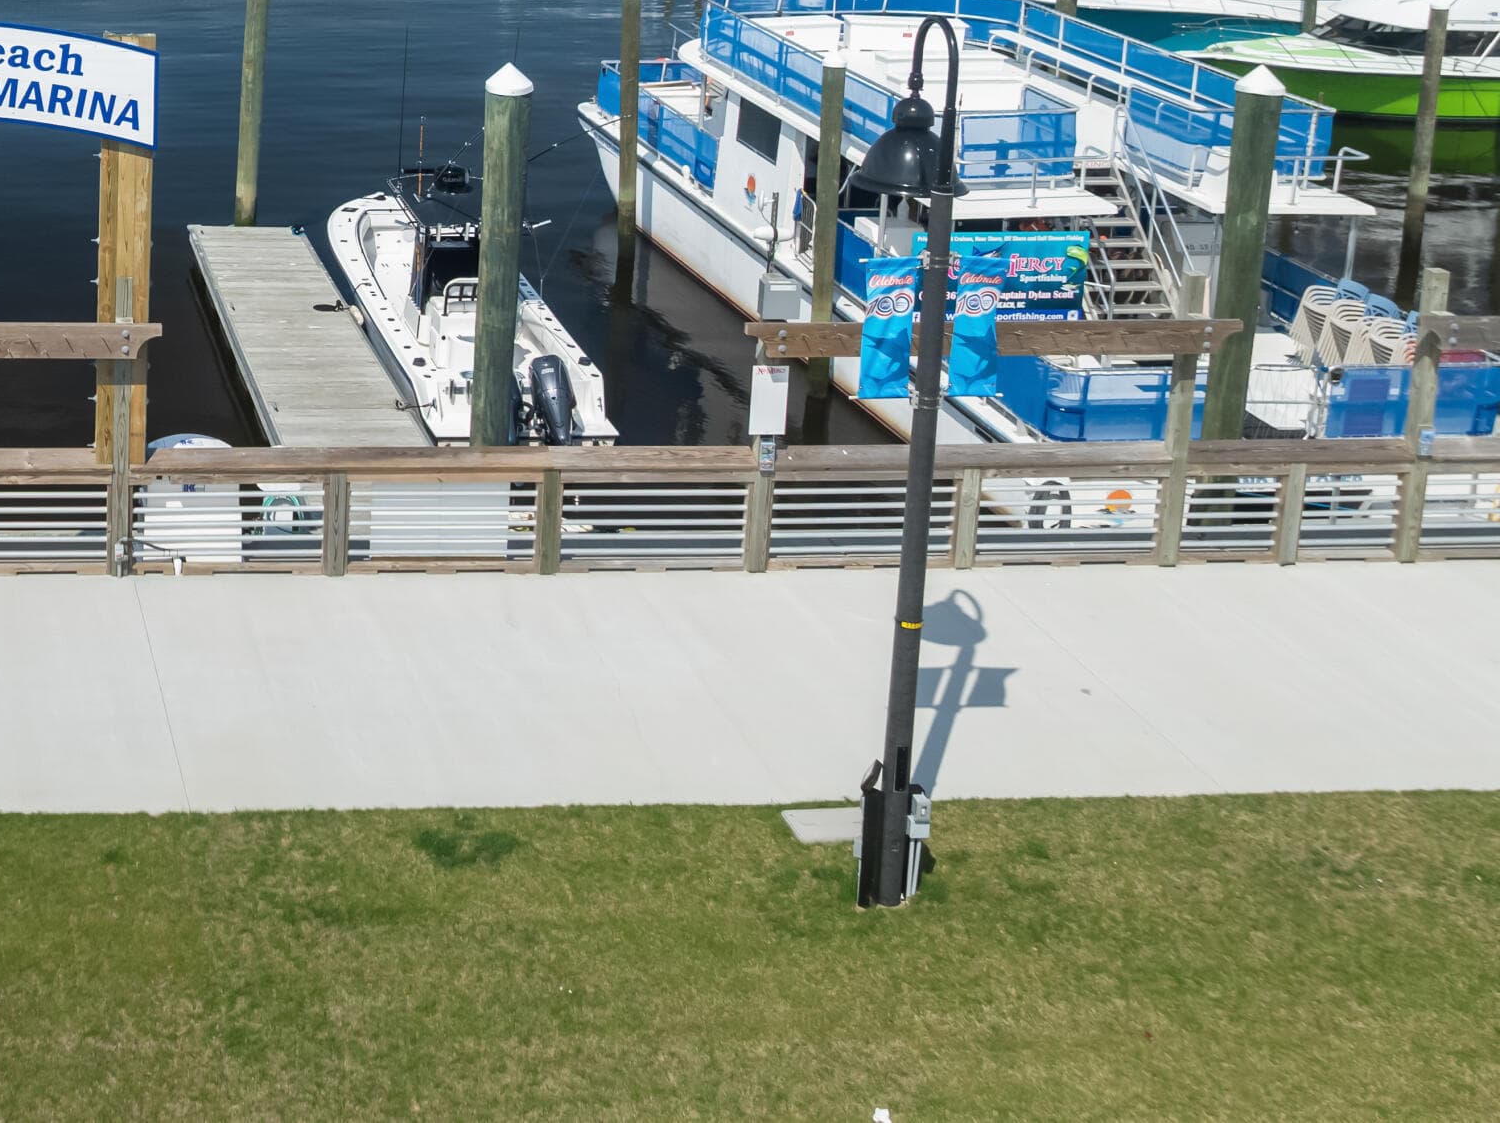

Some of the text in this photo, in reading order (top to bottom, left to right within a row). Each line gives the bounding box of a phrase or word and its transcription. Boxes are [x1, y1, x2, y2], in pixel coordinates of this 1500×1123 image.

[868, 273, 915, 288] Celebrate
[959, 271, 1003, 286] Celebrate
[1019, 274, 1068, 283] Sportfishing
[998, 290, 1074, 301] aptain Dylan Scott
